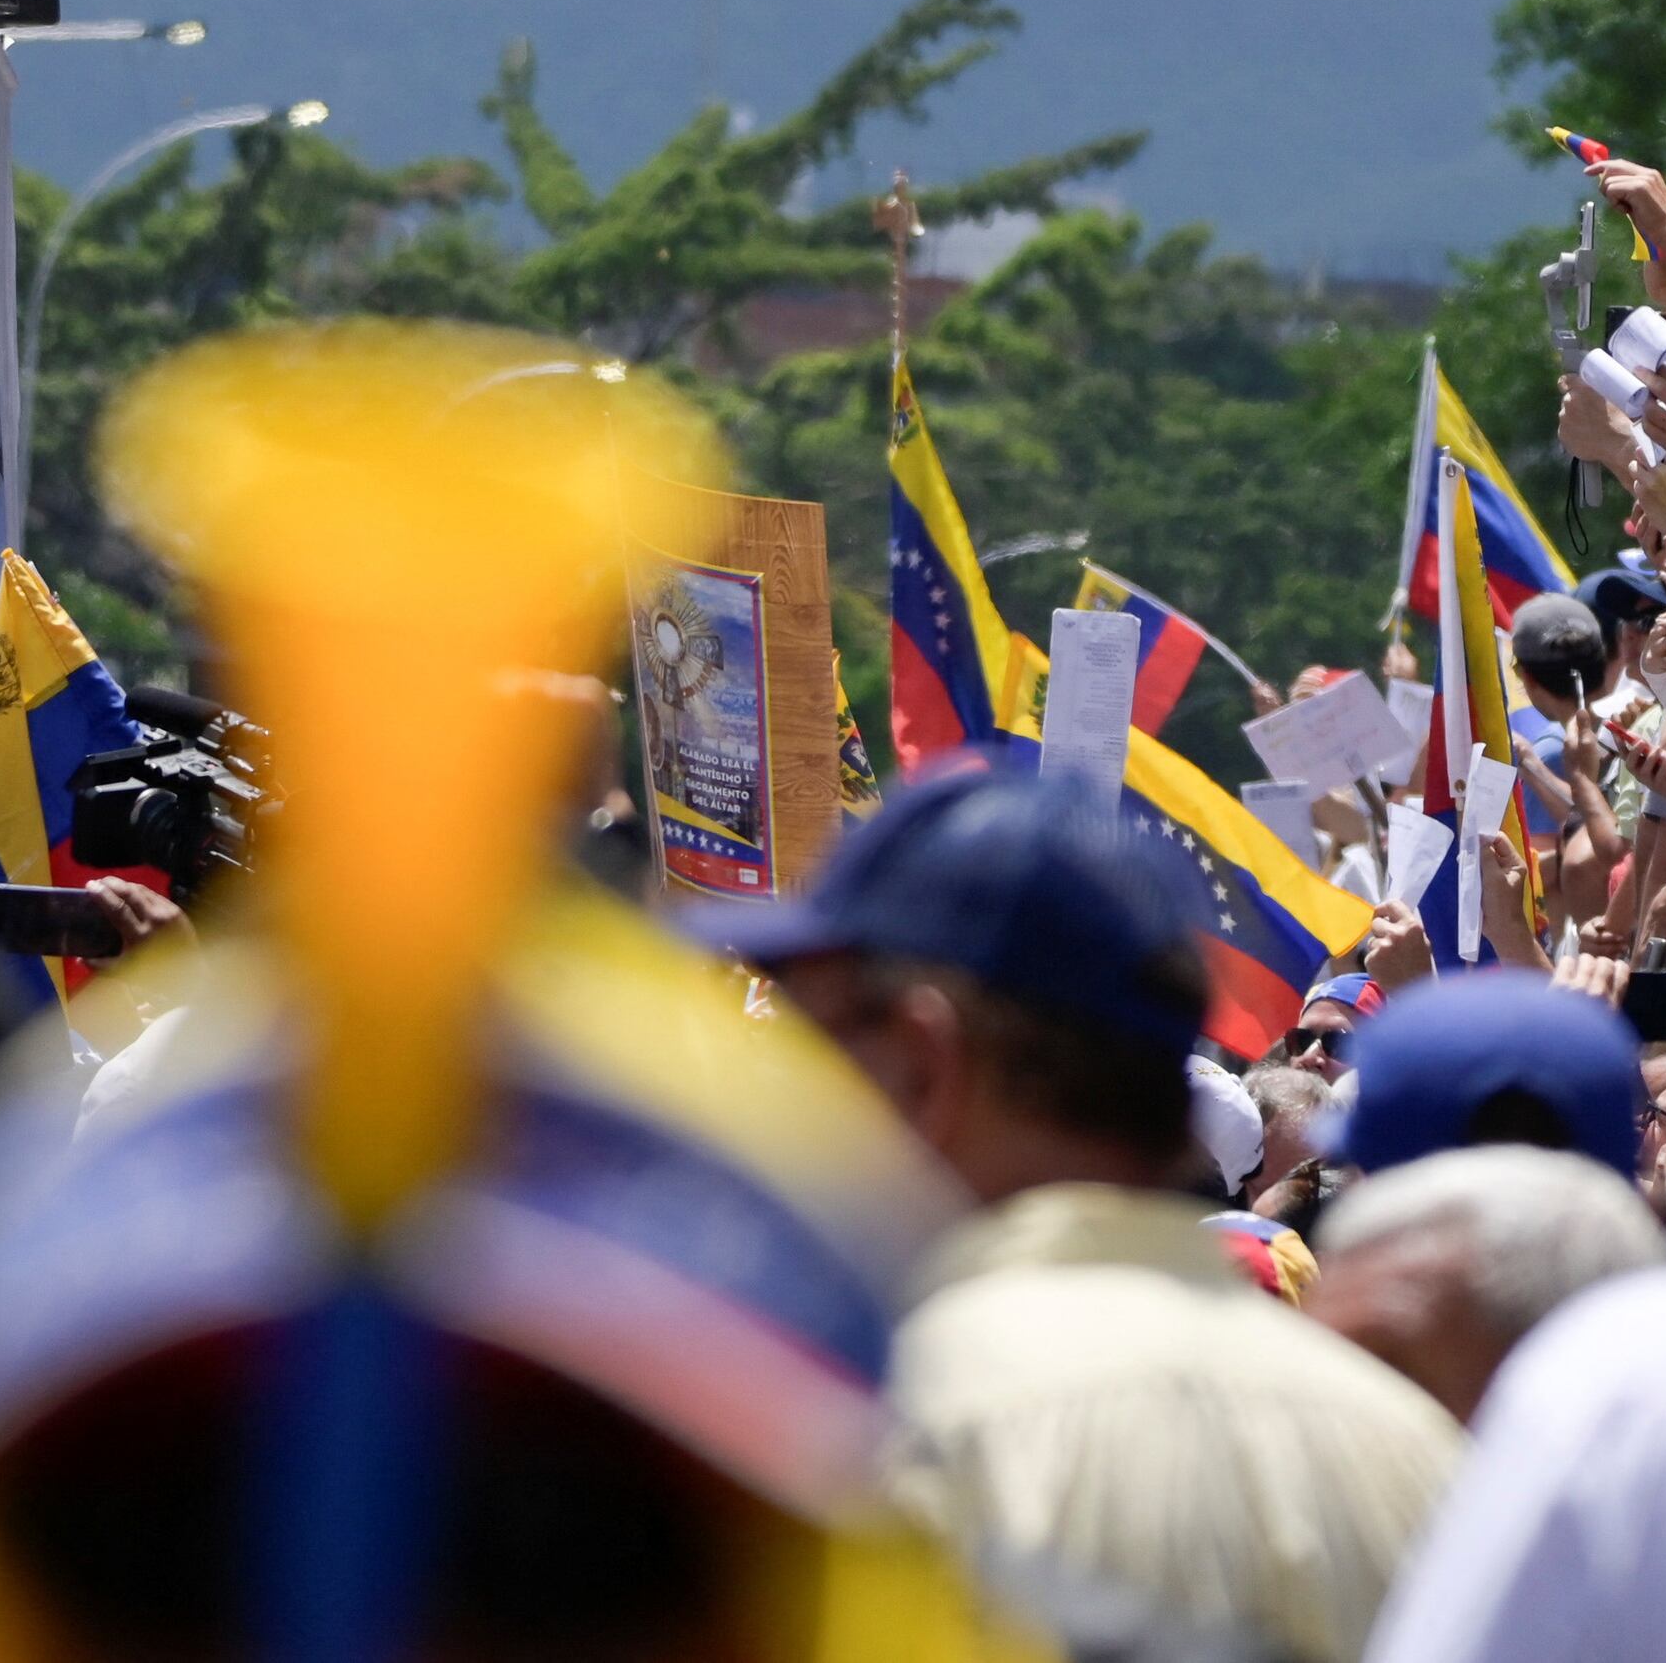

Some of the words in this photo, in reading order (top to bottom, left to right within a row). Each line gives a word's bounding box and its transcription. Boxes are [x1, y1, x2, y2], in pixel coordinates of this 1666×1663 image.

[679, 746, 719, 765] ALABADO
[721, 758, 741, 769] SEA
[743, 761, 755, 771] EL
[685, 778, 750, 800] SACRAMENTO
[692, 795, 709, 807] DEL
